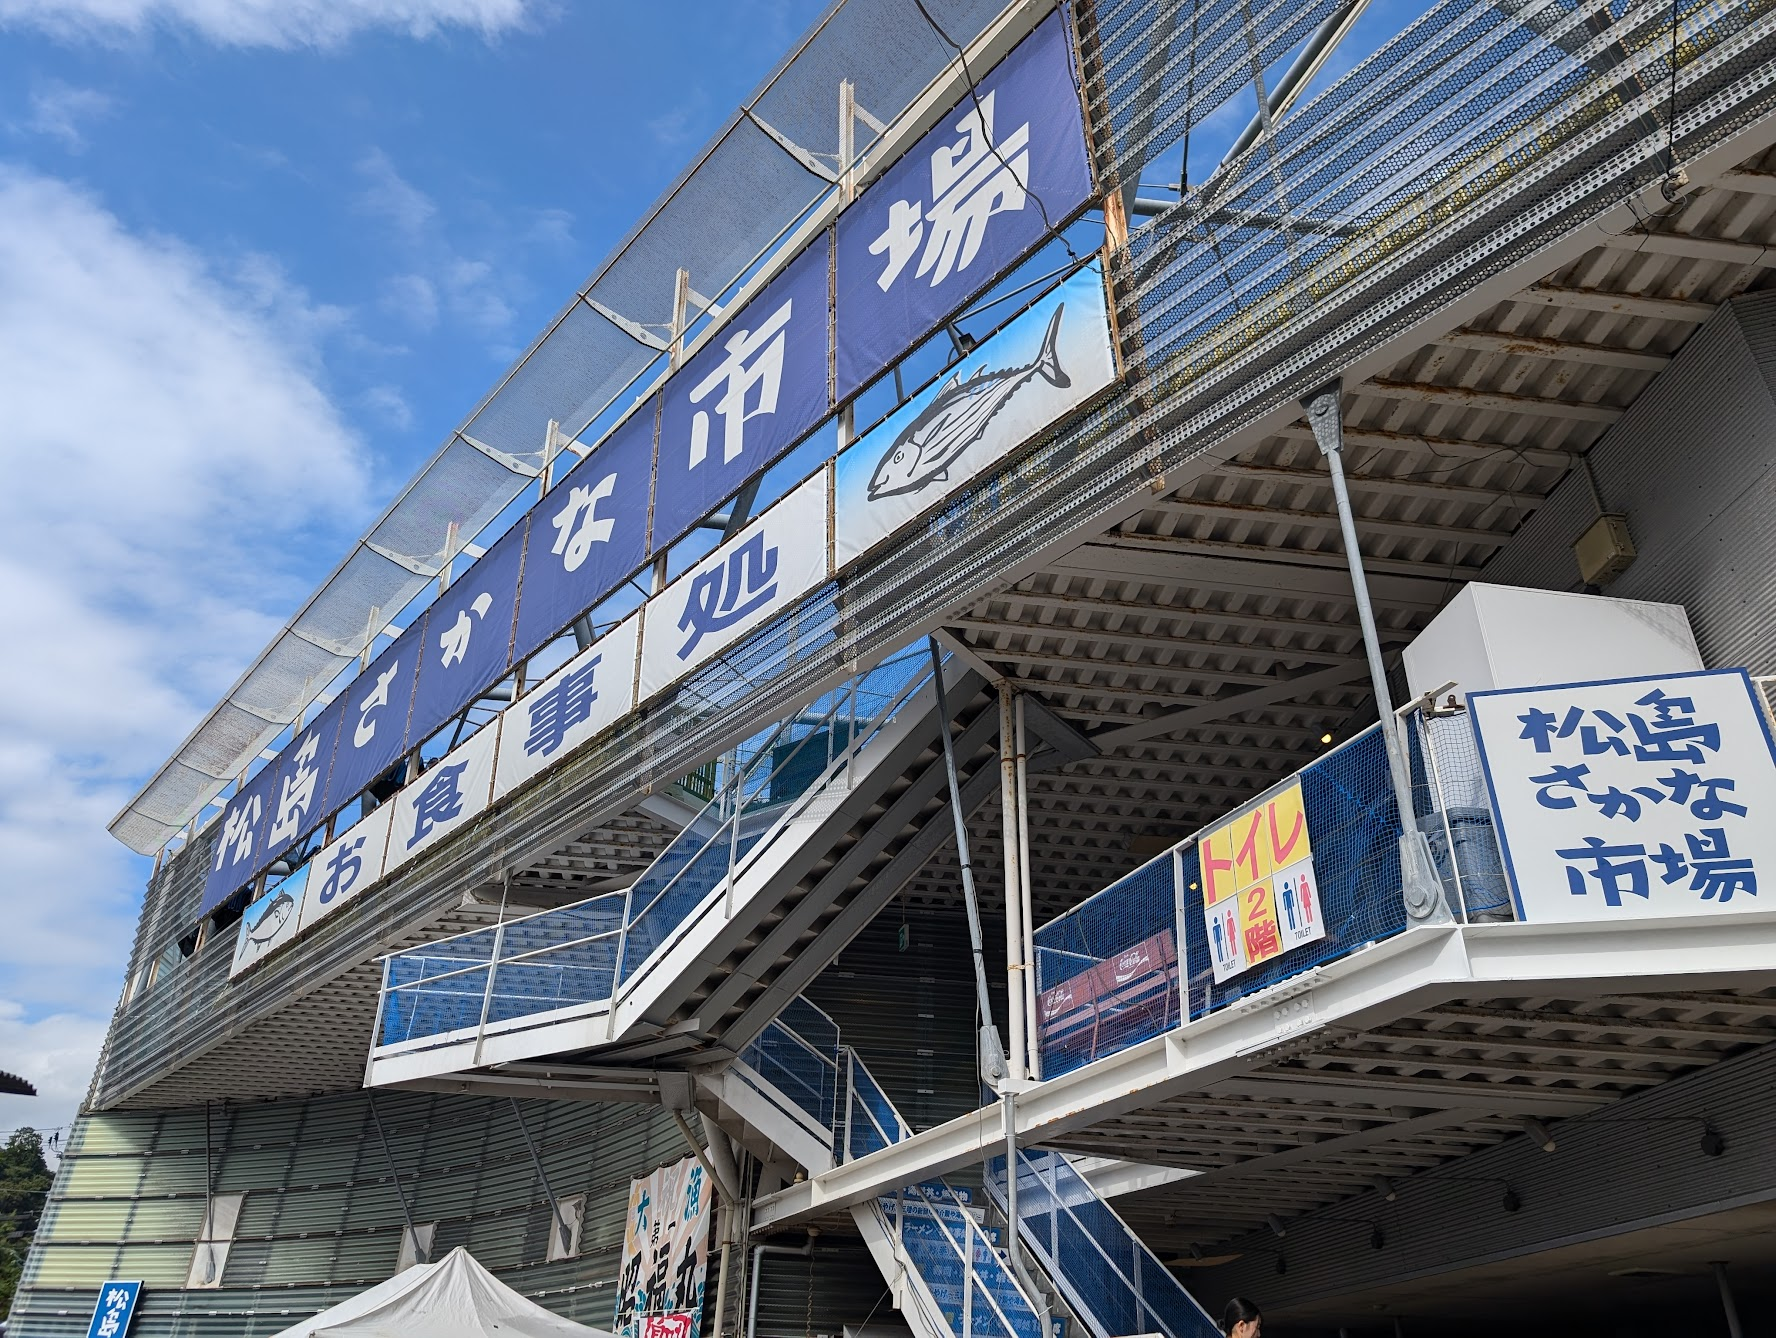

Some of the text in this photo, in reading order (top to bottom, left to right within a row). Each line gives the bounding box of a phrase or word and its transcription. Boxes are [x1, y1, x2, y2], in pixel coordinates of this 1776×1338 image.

[215, 89, 1029, 871] 松島さかな市場
[319, 536, 778, 904] お食事処
[1516, 687, 1720, 765] 松島
[1528, 763, 1748, 823] さかな
[1203, 802, 1303, 905] トイレ
[1555, 827, 1757, 907] 市場
[1245, 887, 1279, 963] 2階
[1294, 926, 1312, 941] TOILET
[1222, 958, 1237, 973] TOILET
[97, 1288, 130, 1338] 松島
